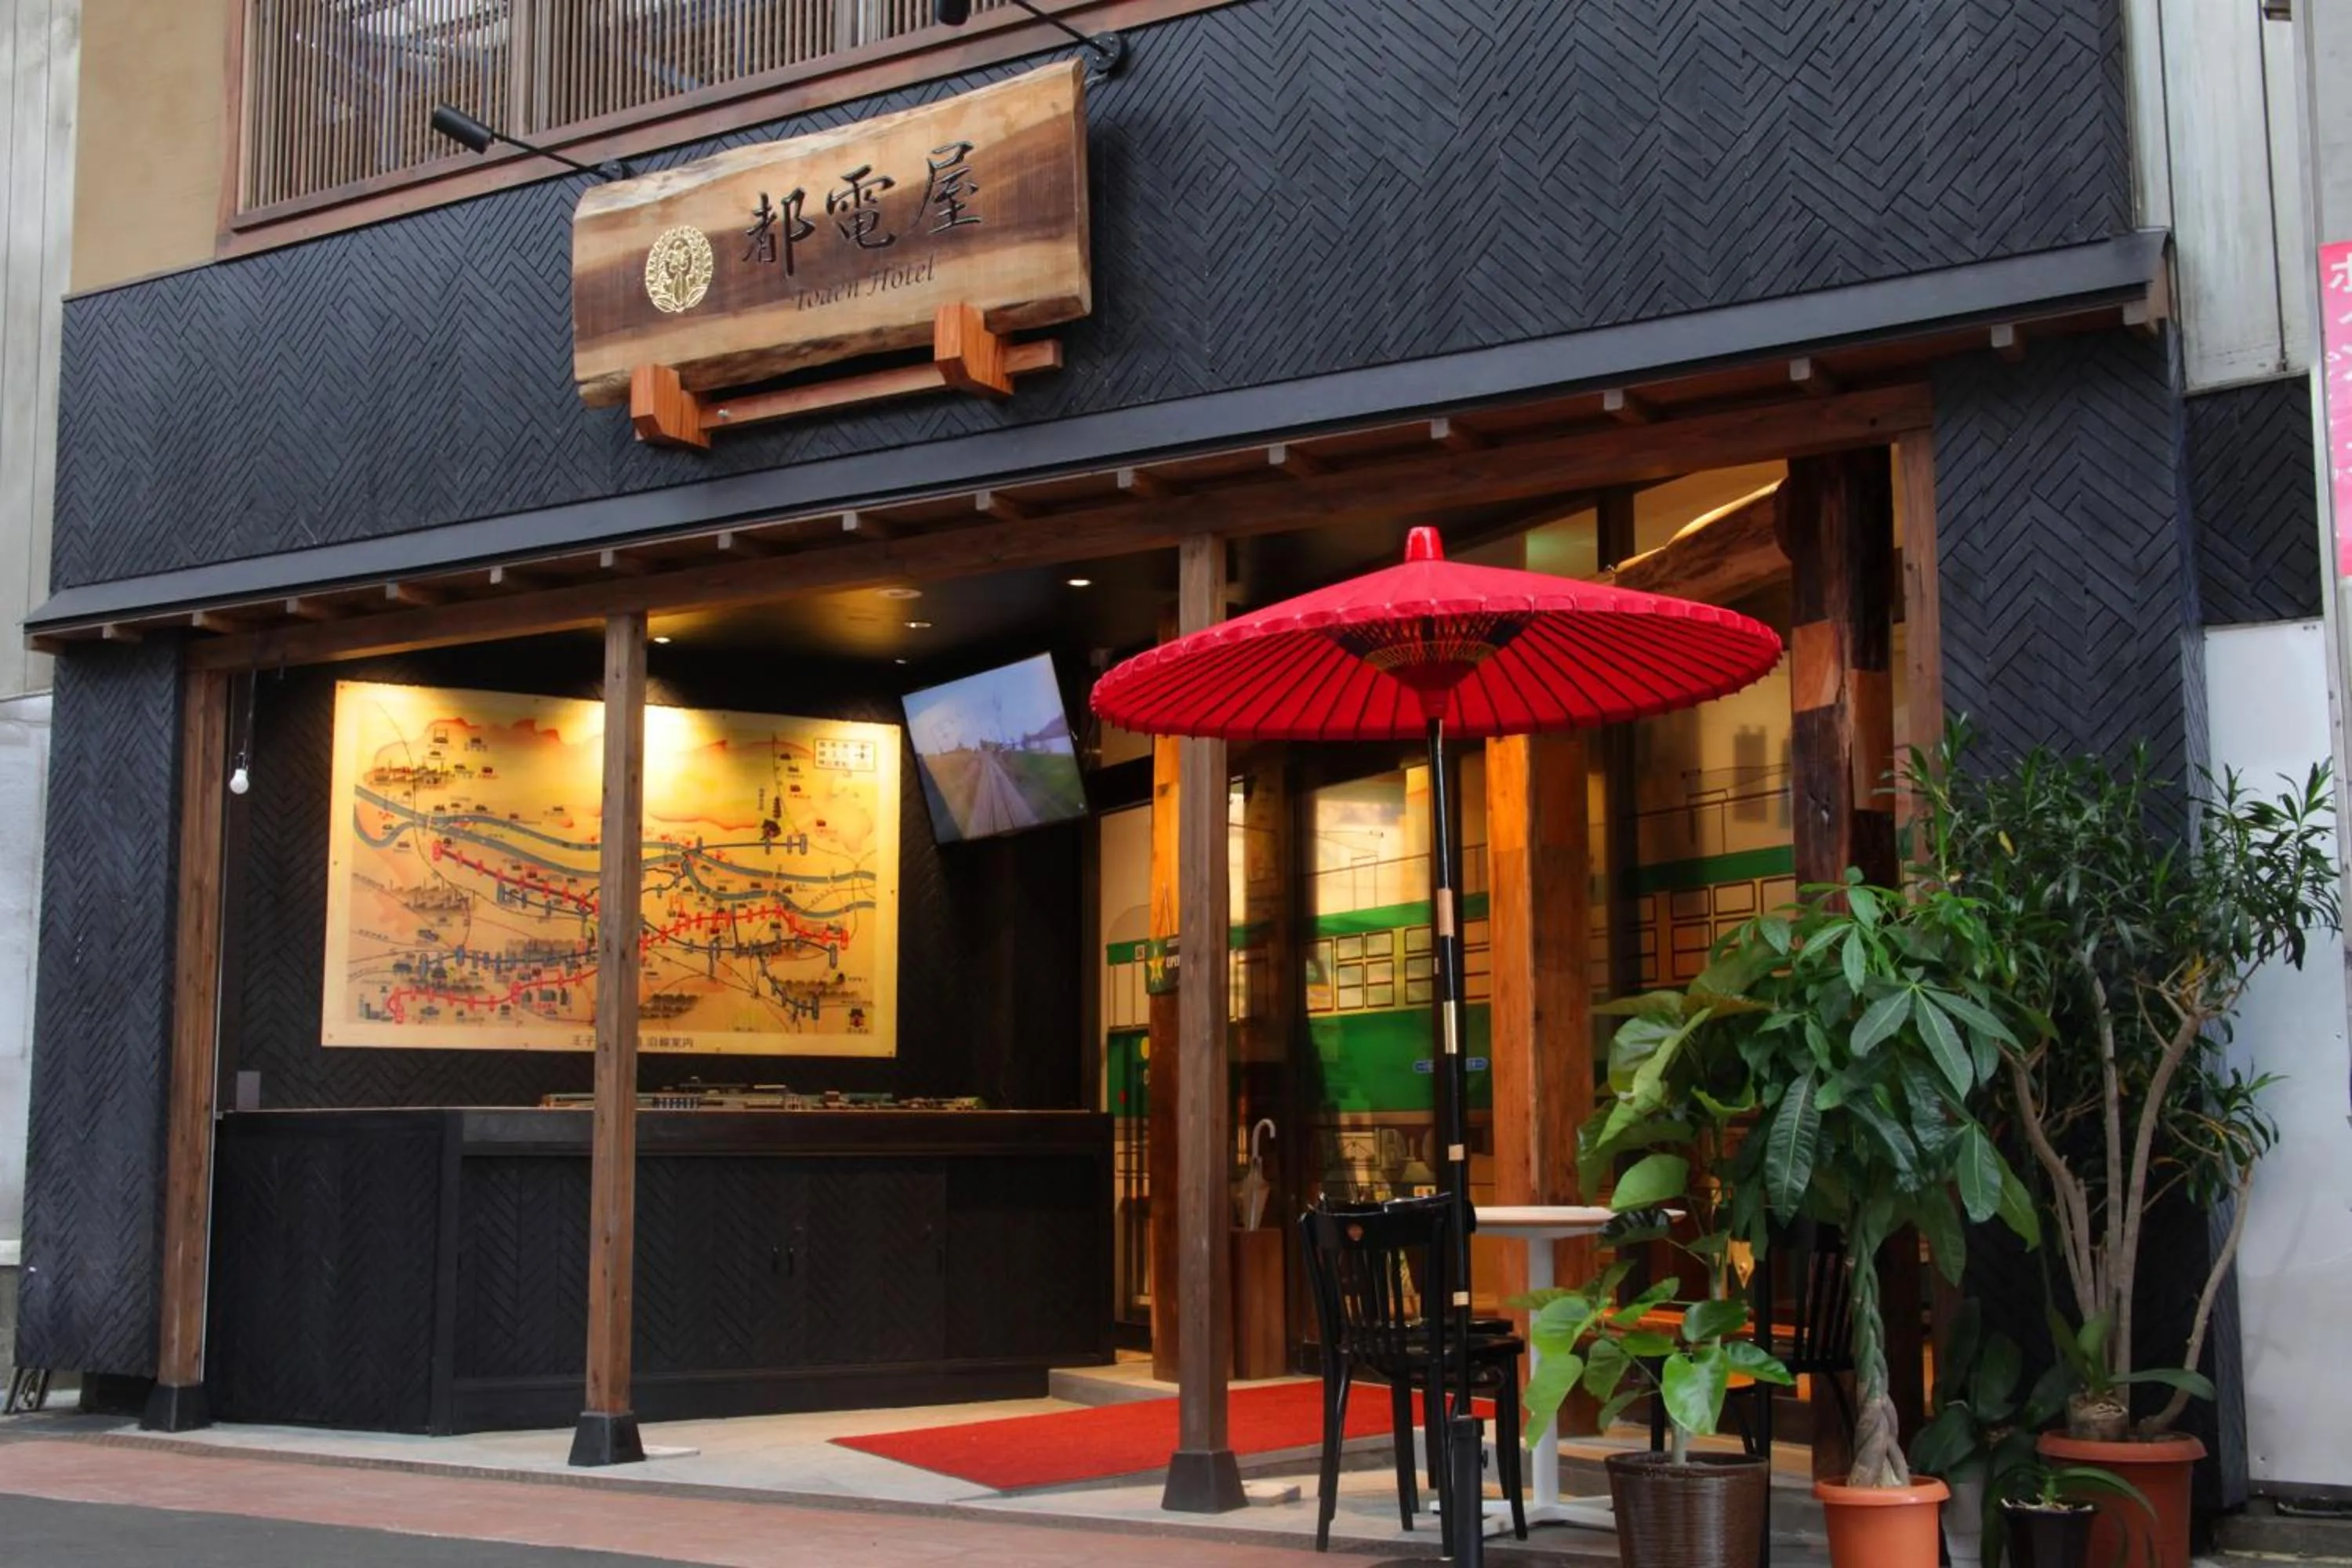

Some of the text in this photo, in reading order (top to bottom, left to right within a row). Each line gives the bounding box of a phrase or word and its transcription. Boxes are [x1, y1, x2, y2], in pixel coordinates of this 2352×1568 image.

[742, 140, 982, 276] 都電屋
[866, 253, 936, 296] Hotel
